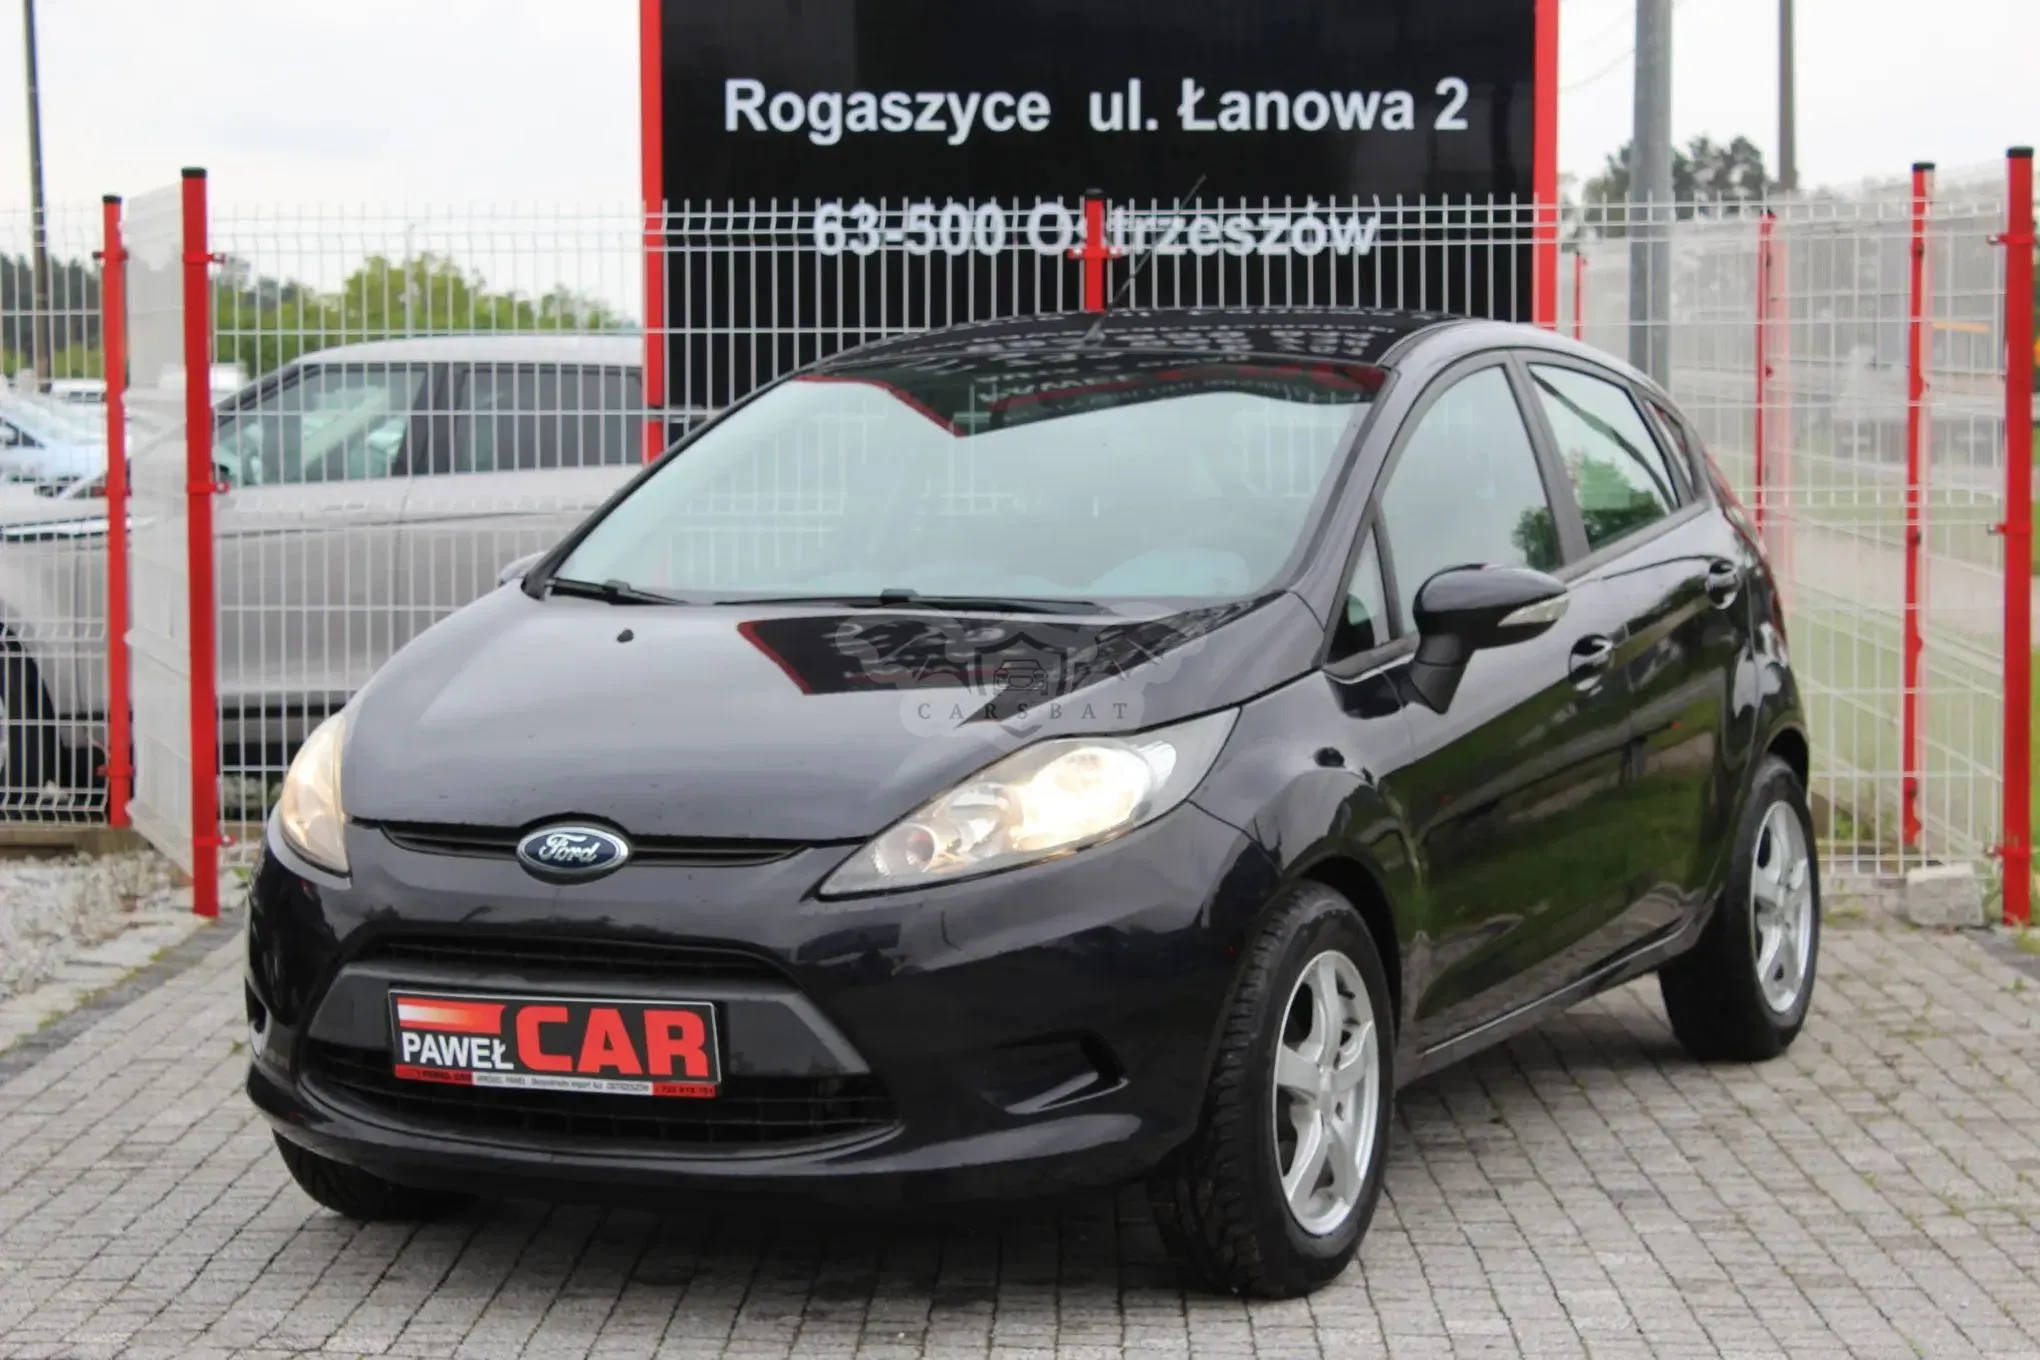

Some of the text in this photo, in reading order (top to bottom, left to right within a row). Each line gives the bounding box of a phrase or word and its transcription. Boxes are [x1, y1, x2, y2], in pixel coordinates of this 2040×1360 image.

[725, 76, 1469, 145] Rogaszyce ul. Łanowa 2
[813, 202, 1006, 256] 63-500
[538, 833, 601, 862] Ford
[402, 1004, 709, 1077] PAWEŁ CAR
